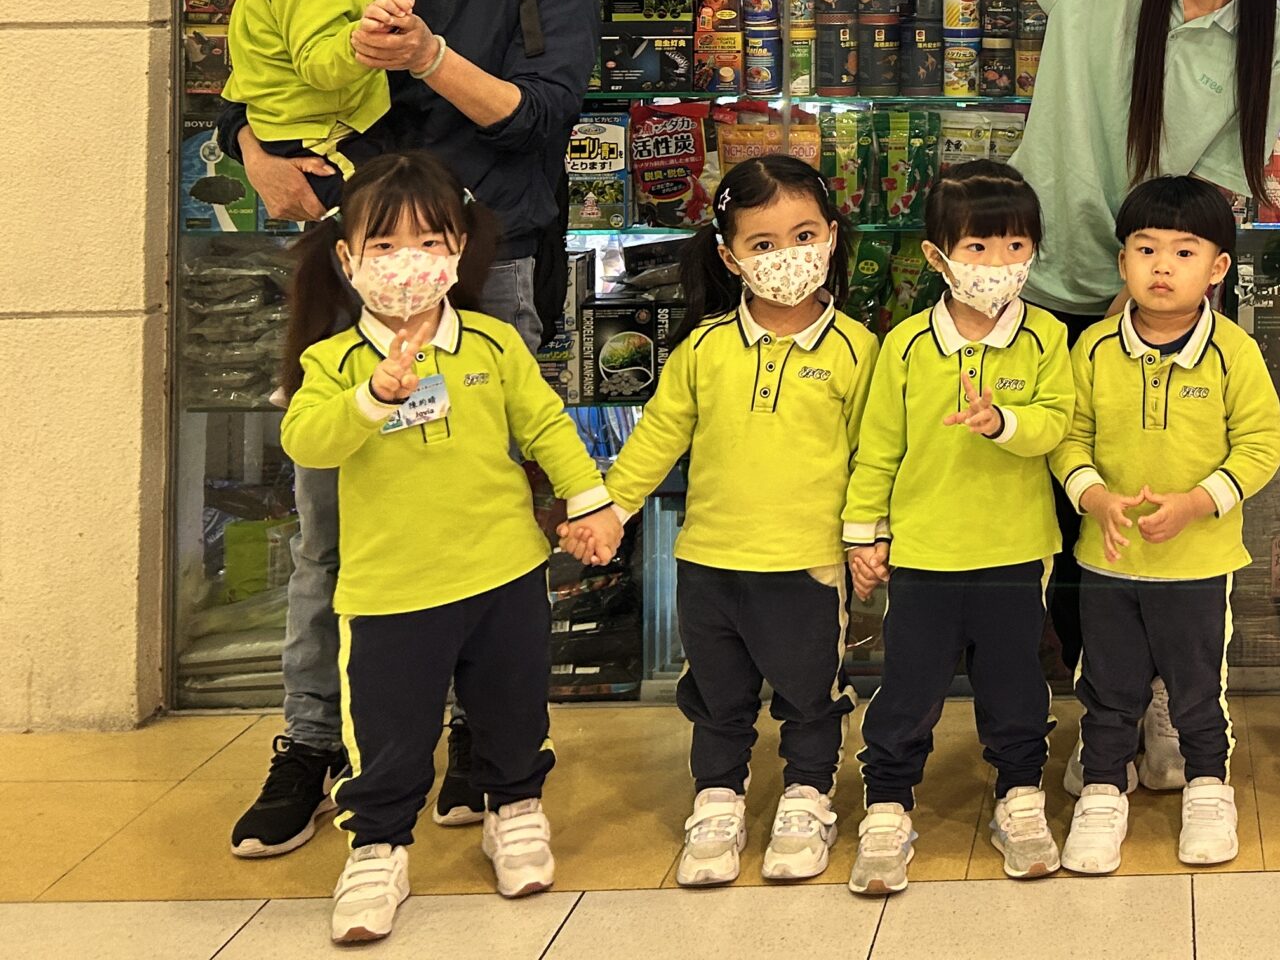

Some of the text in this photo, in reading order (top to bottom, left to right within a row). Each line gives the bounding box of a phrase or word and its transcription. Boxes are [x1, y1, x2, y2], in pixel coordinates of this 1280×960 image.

[184, 120, 214, 128] BOYU
[632, 133, 696, 160] 活性炭
[546, 340, 575, 350] キレイ!
[415, 408, 435, 418] Jovia
